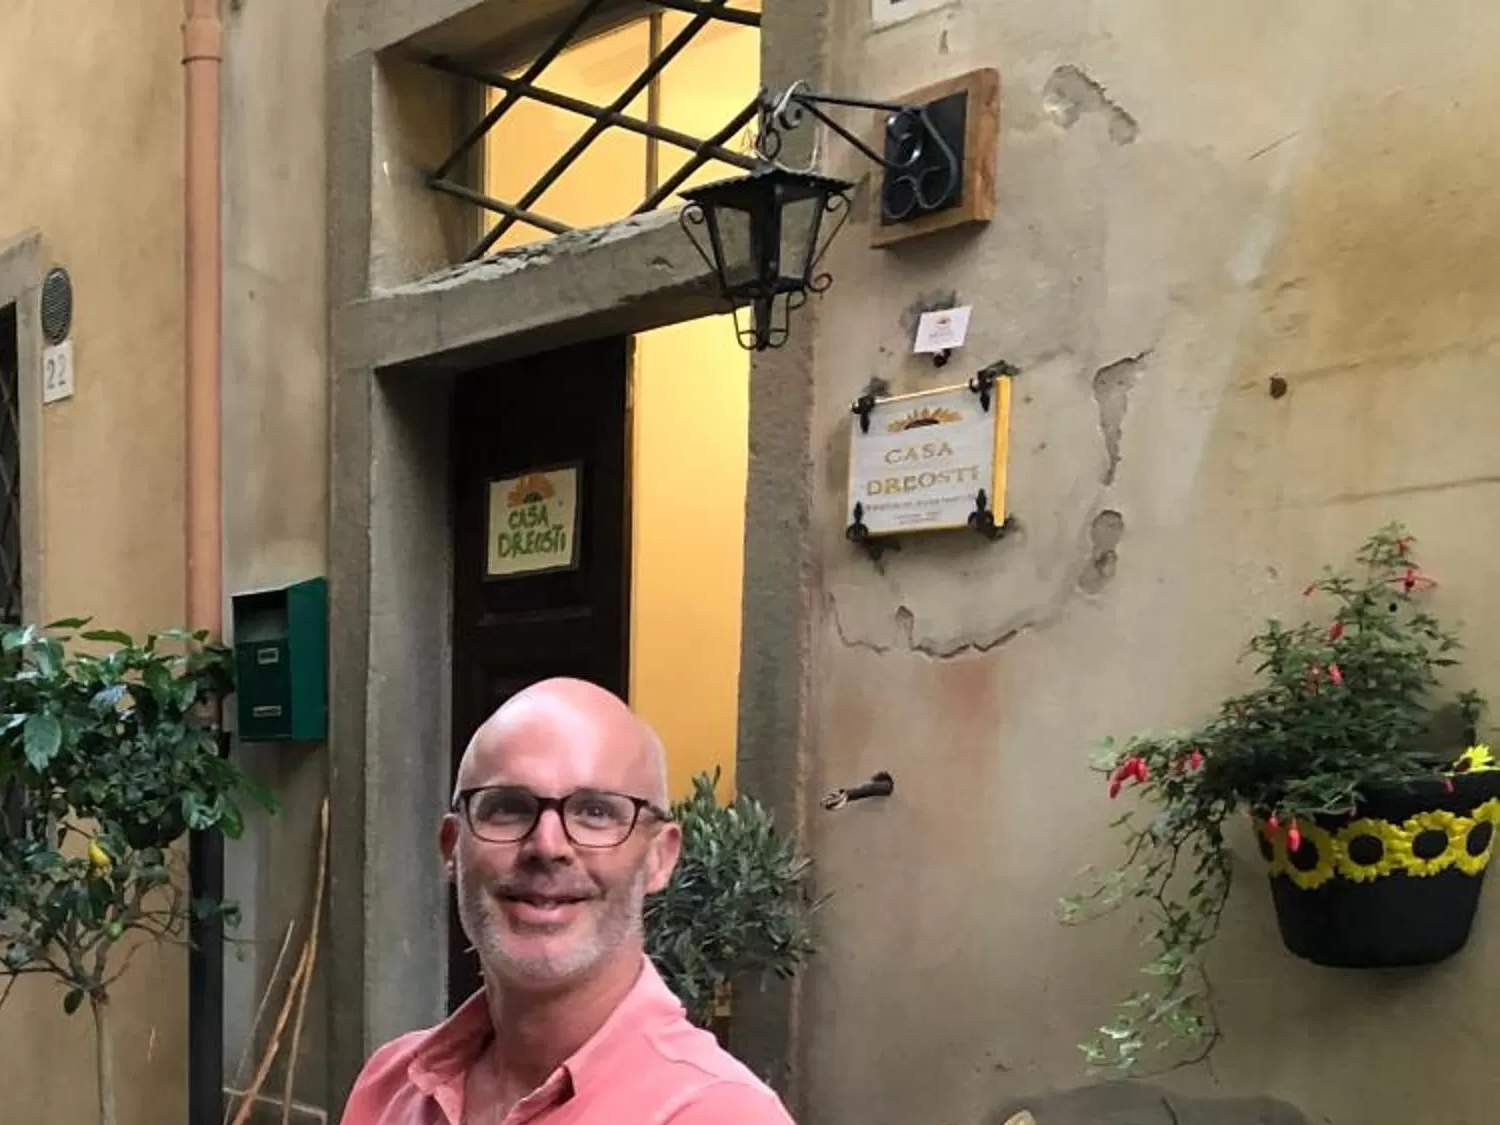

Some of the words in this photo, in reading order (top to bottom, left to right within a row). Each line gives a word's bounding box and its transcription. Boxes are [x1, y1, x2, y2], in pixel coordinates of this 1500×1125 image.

[46, 353, 67, 390] 22
[884, 441, 955, 465] CASA
[866, 465, 981, 497] DREOSTI
[507, 504, 550, 530] CASA
[497, 524, 567, 559] DREOSTI
